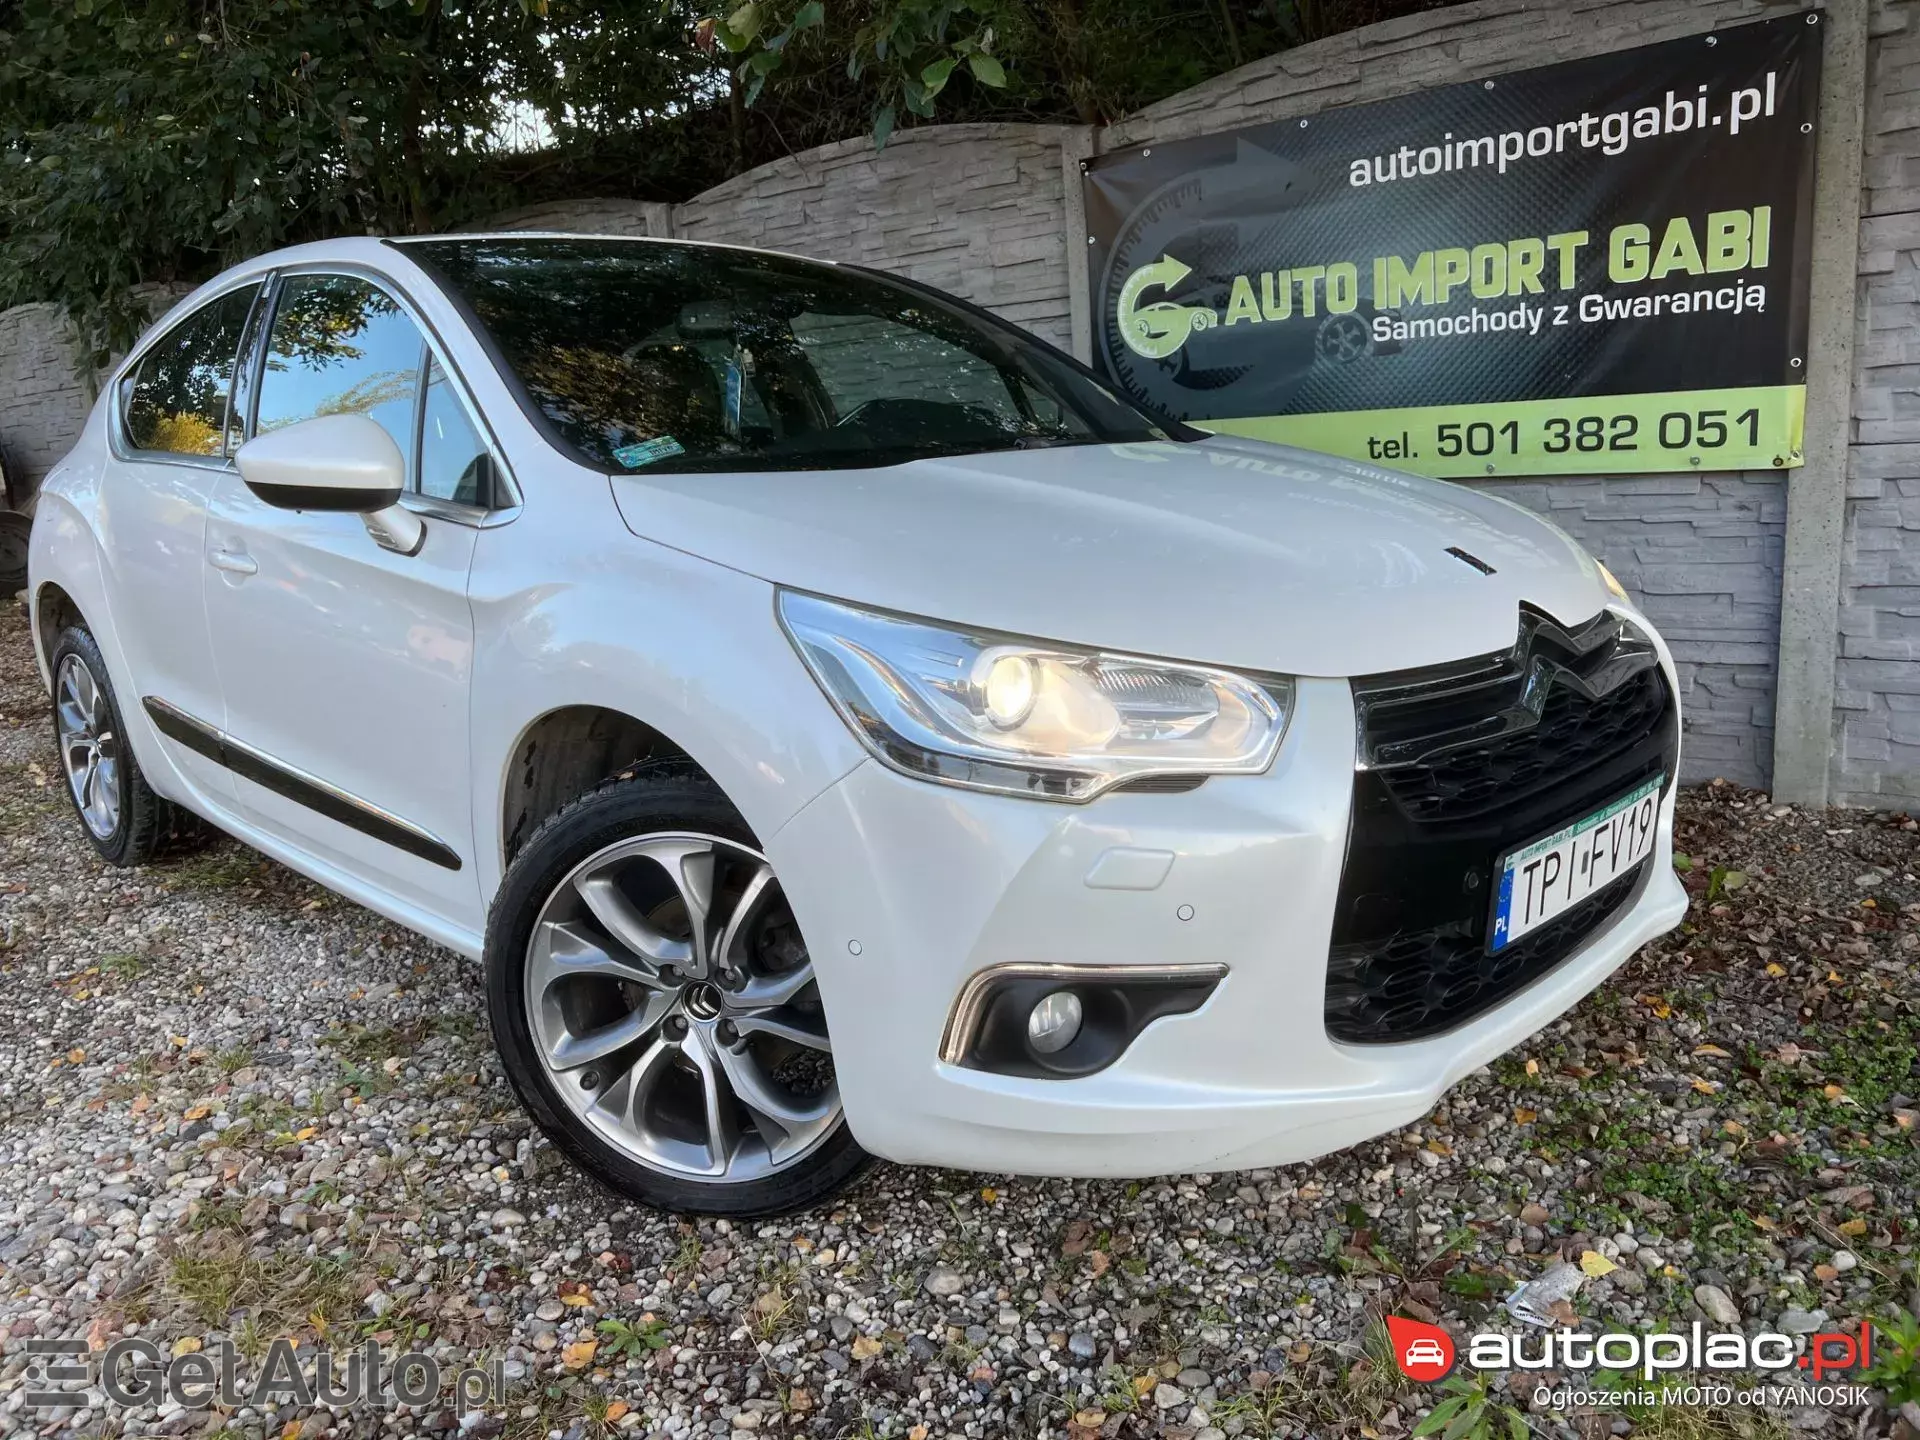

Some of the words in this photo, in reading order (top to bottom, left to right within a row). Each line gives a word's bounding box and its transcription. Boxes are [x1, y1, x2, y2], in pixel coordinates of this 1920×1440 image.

[1349, 71, 1777, 187] autoimportgabi.pl
[1224, 261, 1359, 327] AUTO
[1373, 230, 1589, 311] IMPORT
[1608, 205, 1772, 284] GABI
[1371, 302, 1544, 343] Samochody
[1551, 306, 1569, 326] z
[1578, 277, 1767, 323] Gwarancją
[1367, 431, 1419, 461] tel.
[1436, 420, 1519, 457] 501
[1543, 414, 1639, 453] 382
[1657, 408, 1760, 449] 051
[1522, 840, 1576, 925] TPI
[1588, 797, 1653, 888] FV19
[1494, 916, 1508, 936] PL
